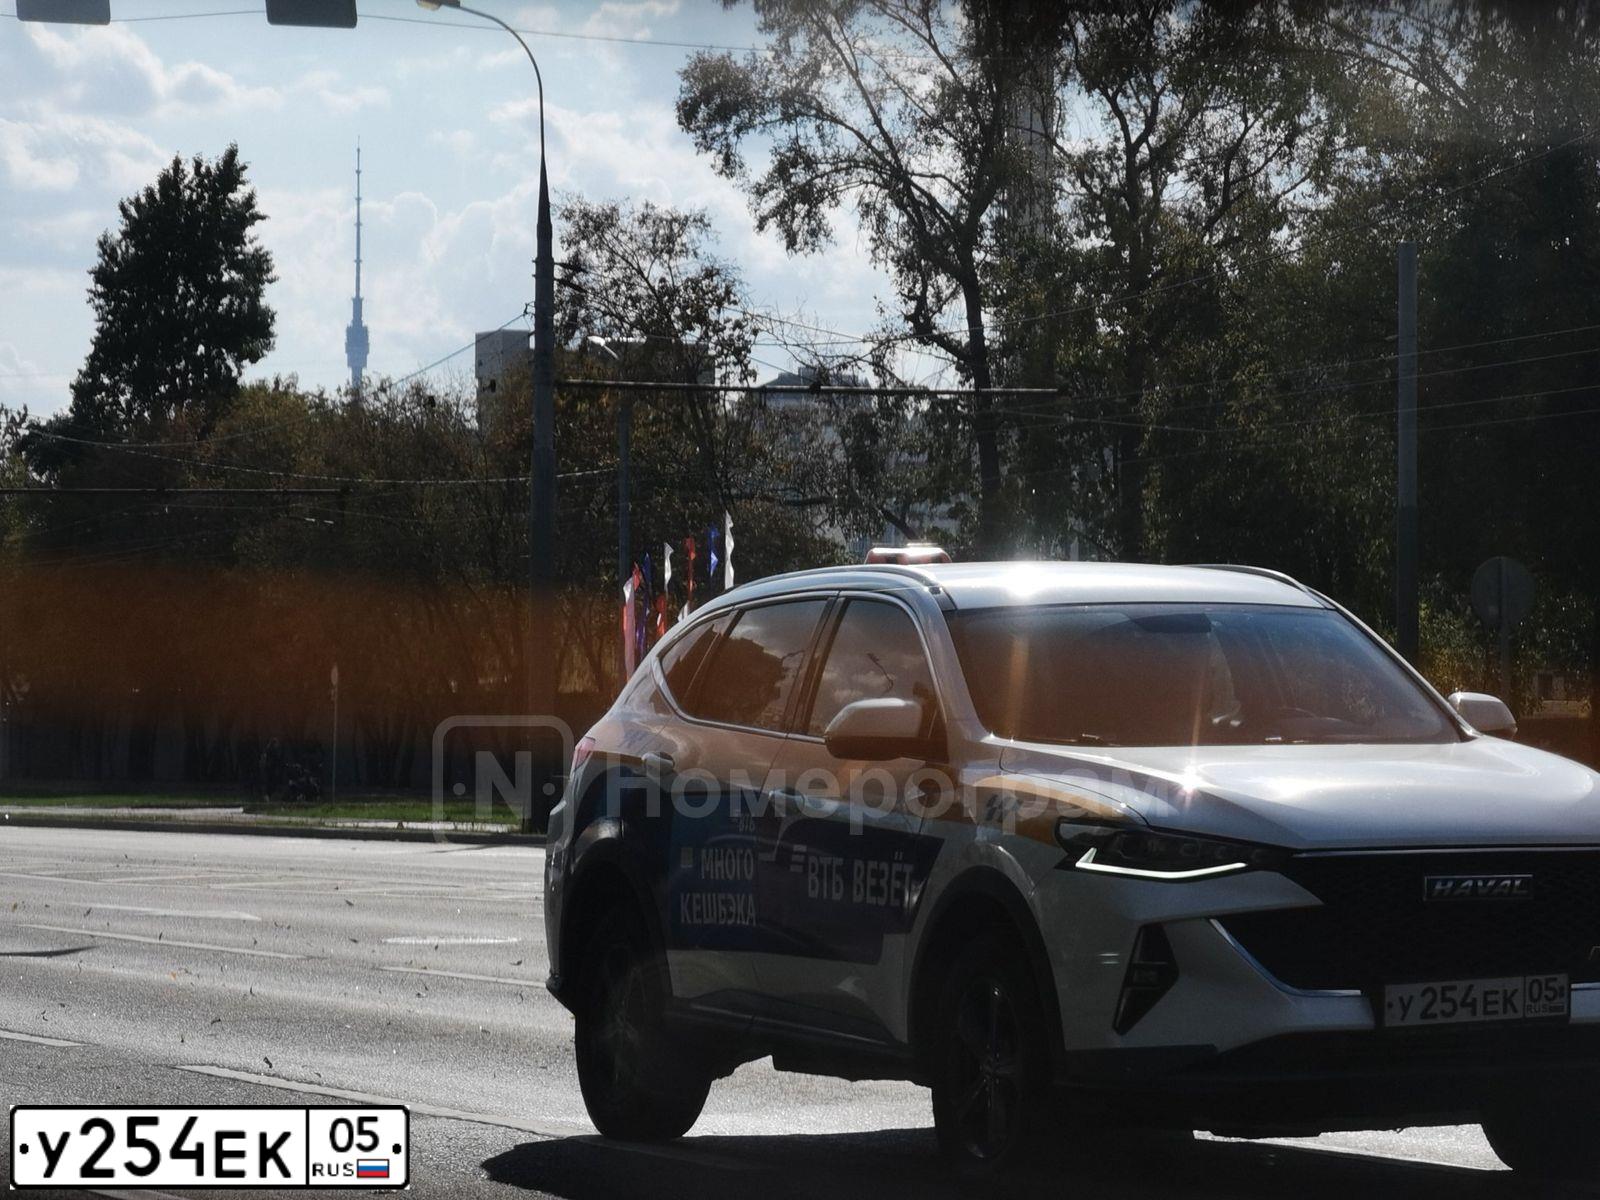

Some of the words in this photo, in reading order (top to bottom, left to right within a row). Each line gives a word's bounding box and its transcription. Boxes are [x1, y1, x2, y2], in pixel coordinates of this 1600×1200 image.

[701, 847, 754, 880] МНОГО
[807, 856, 844, 900] ВТБ
[852, 851, 914, 908] ВЕЗЁТ
[1432, 879, 1528, 896] HAVAL
[680, 892, 756, 926] КЕШБЭКА
[1528, 977, 1558, 1004] 05
[1526, 1003, 1548, 1014] RUS
